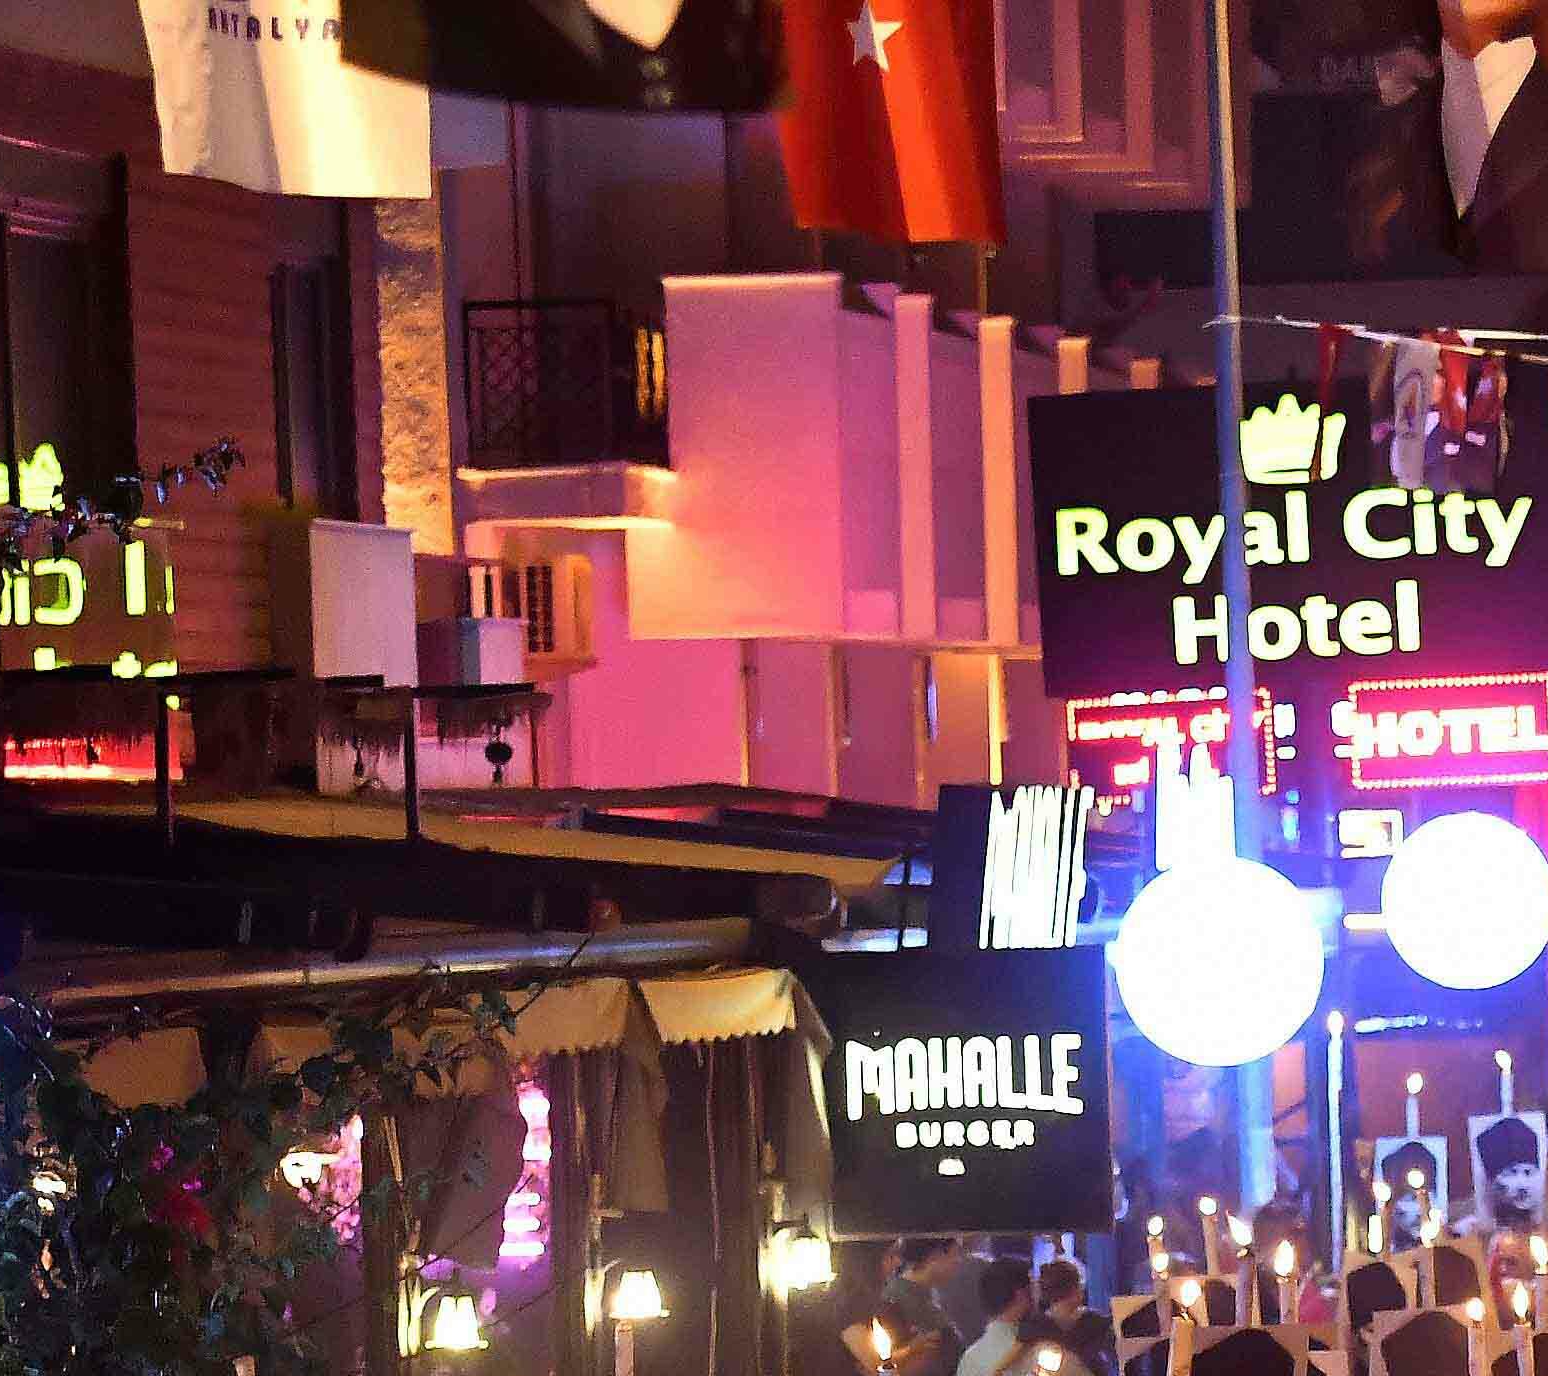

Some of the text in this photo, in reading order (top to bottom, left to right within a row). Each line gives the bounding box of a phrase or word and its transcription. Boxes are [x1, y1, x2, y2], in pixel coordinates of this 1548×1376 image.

[1055, 487, 1533, 584] Royal City
[1173, 579, 1420, 665] Hotel
[1355, 706, 1548, 758] HOTEL
[845, 1033, 1084, 1121] MAHALLE
[895, 1119, 1036, 1150] BURGER
